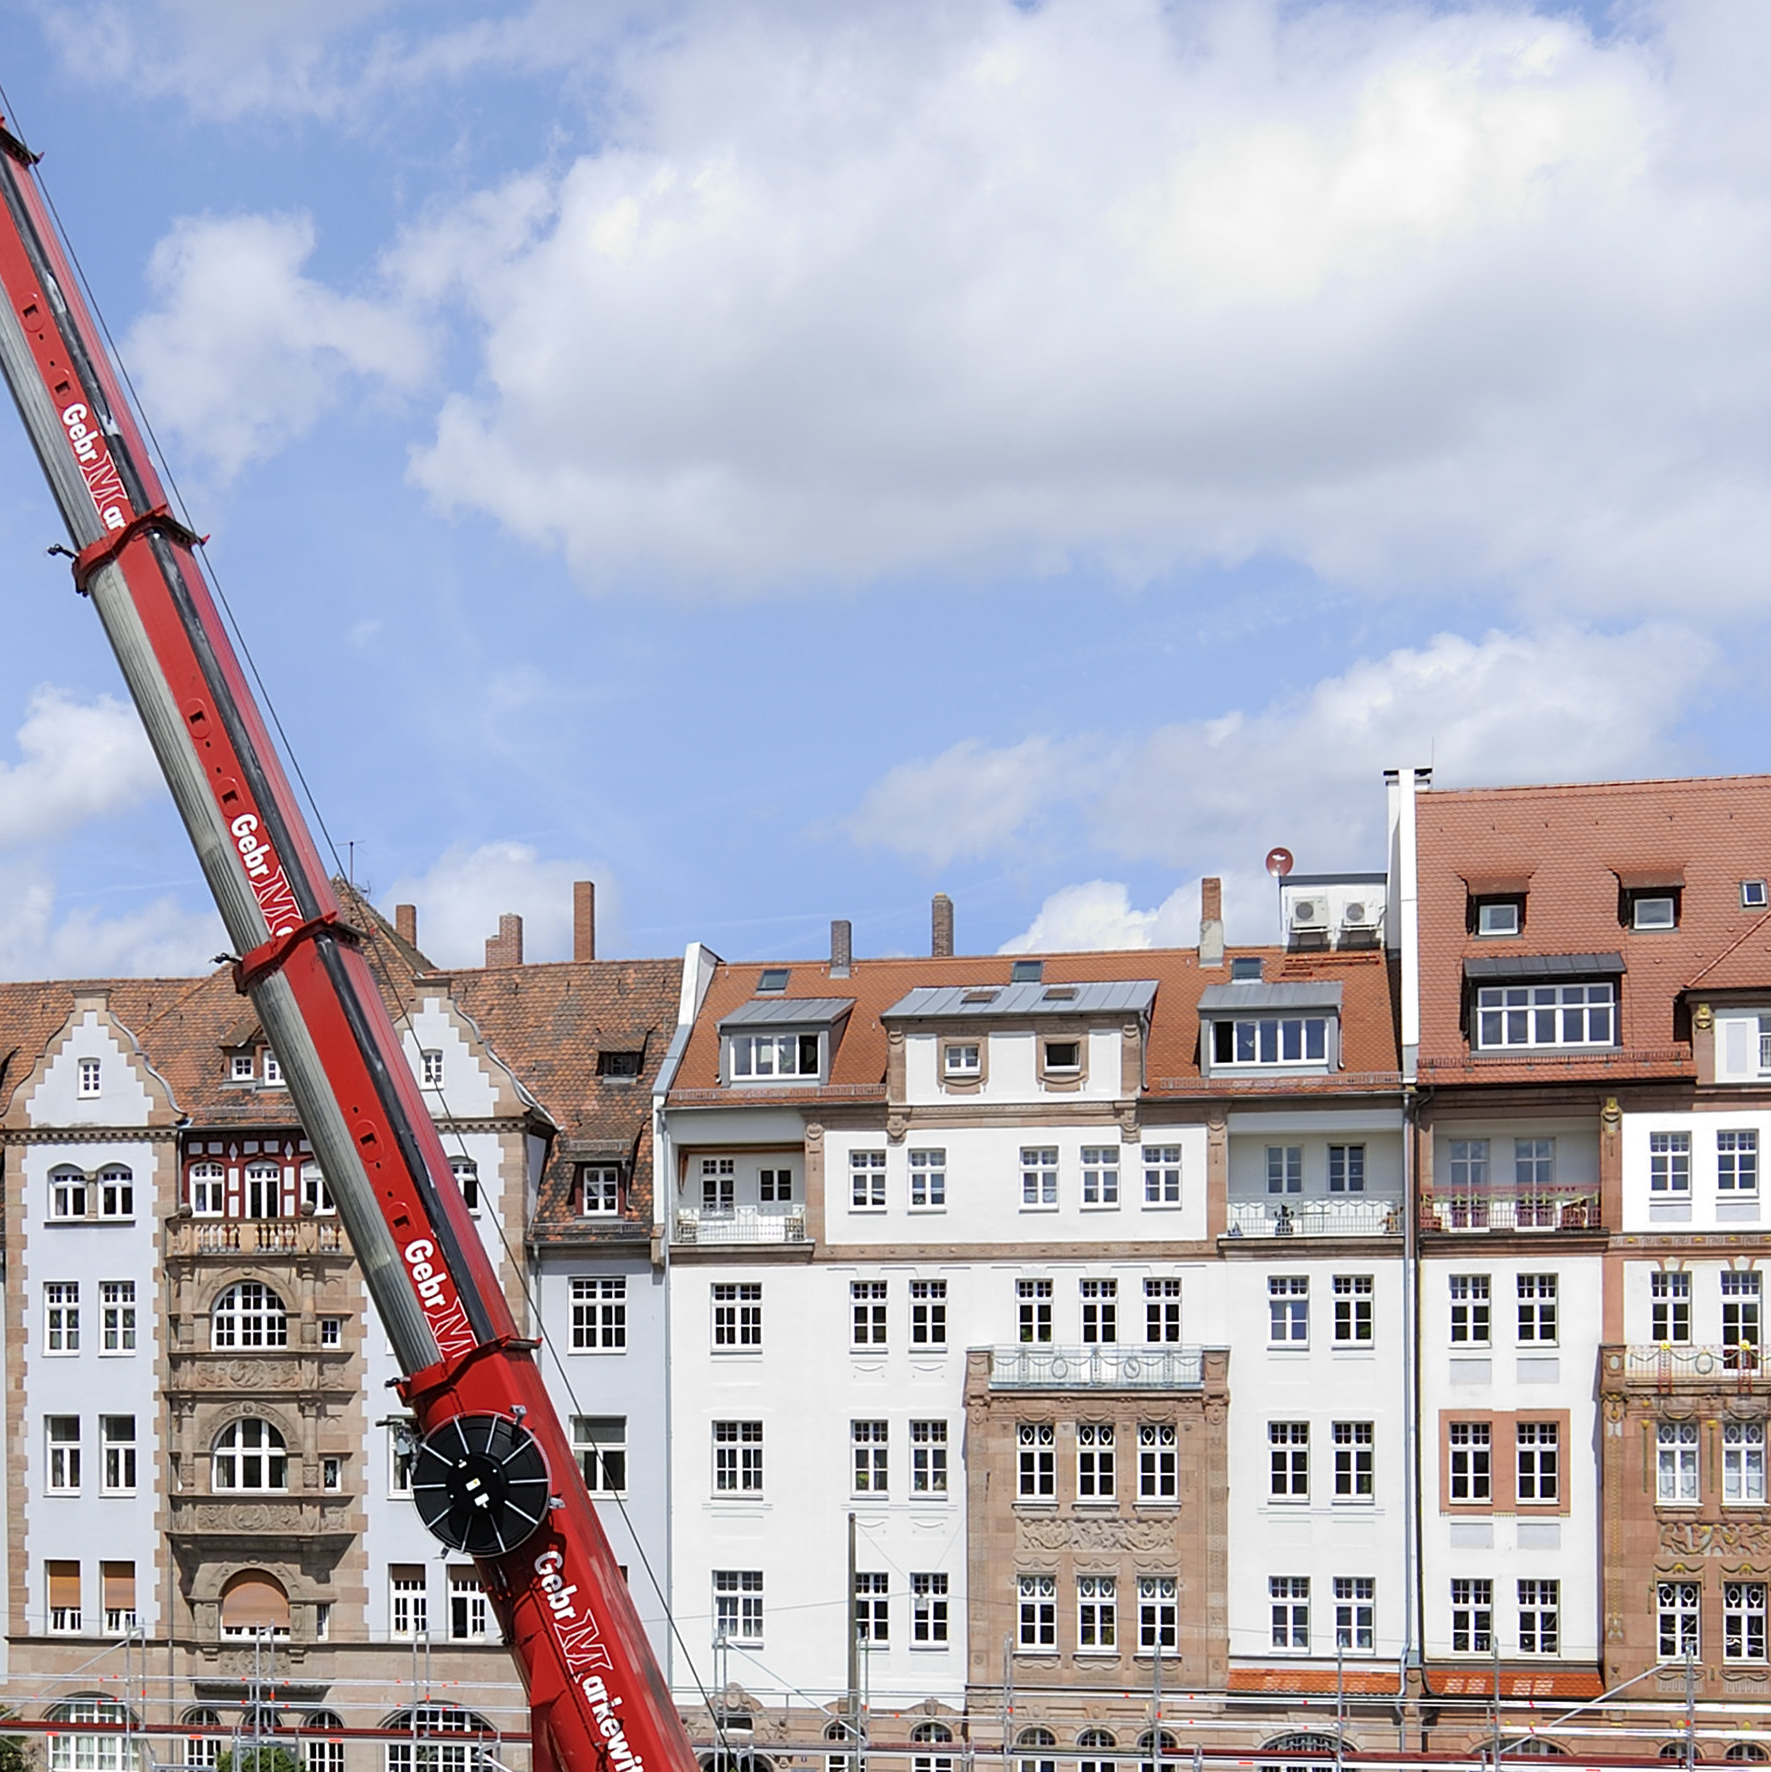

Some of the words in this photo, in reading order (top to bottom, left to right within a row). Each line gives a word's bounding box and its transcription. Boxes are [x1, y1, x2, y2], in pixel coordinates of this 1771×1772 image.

[62, 403, 98, 463] Gebr
[231, 813, 271, 878] Gebr
[404, 1239, 447, 1307] Gebr
[534, 1551, 577, 1619] Gebr
